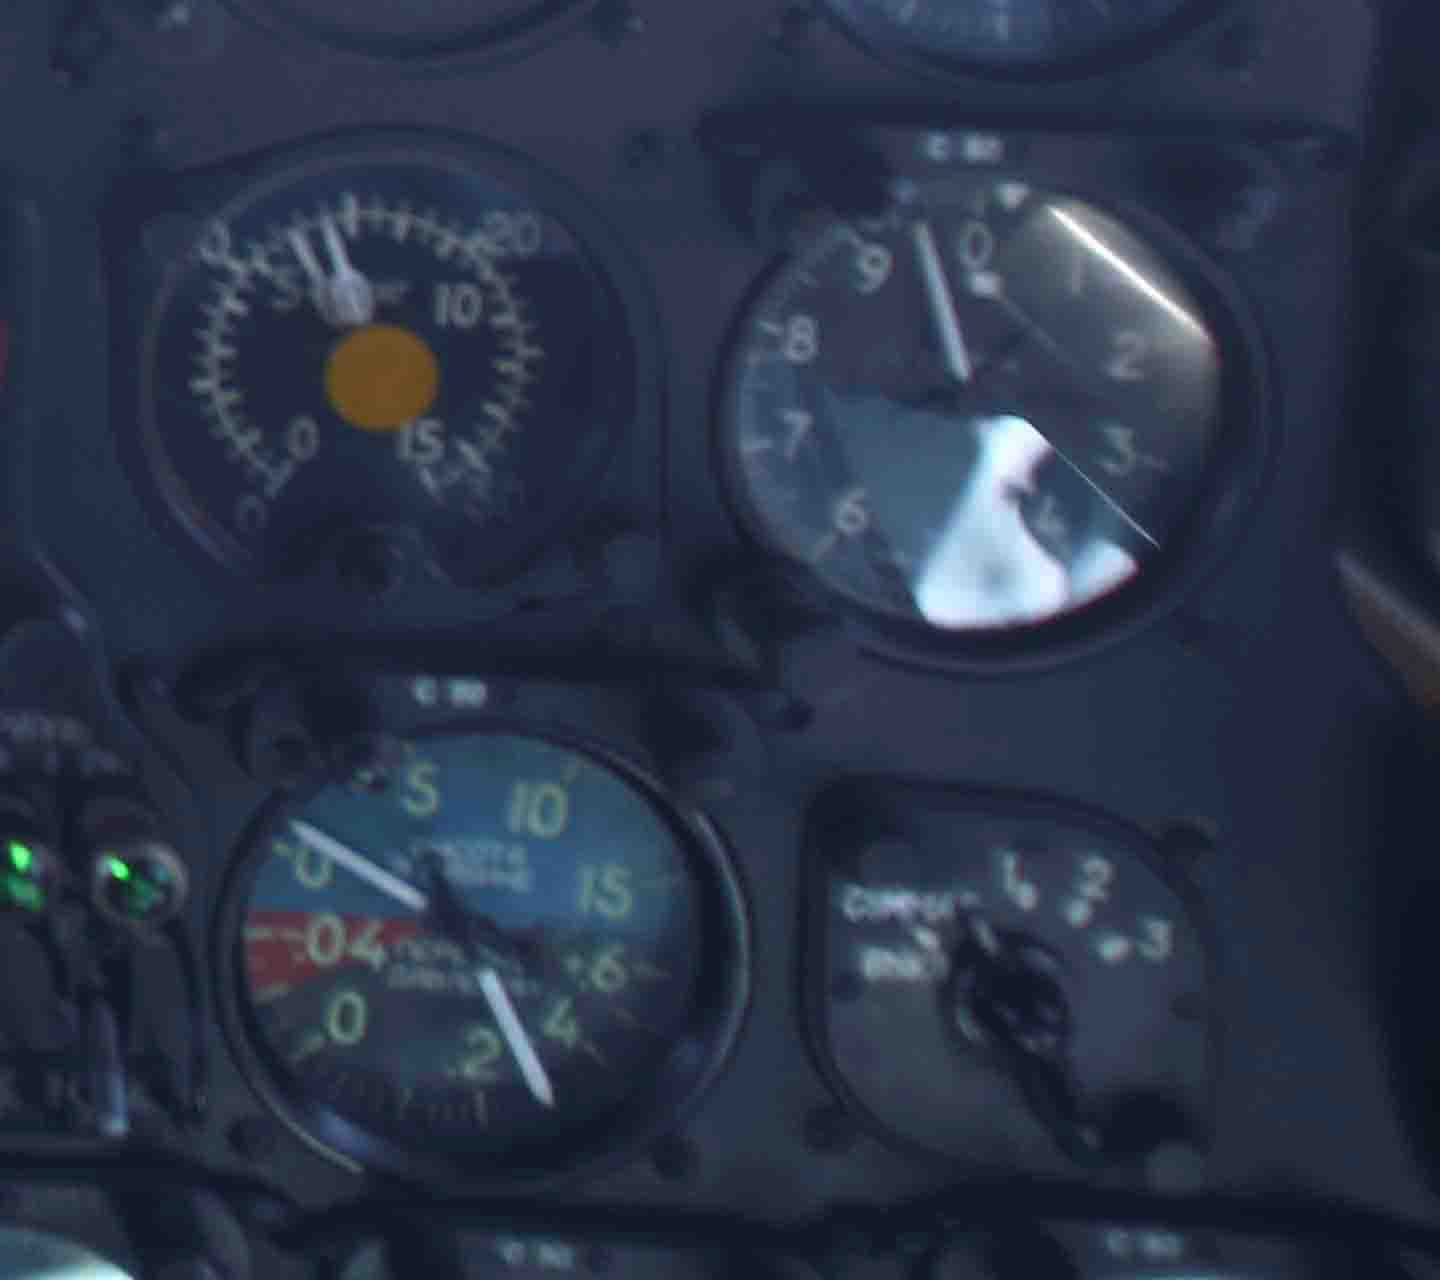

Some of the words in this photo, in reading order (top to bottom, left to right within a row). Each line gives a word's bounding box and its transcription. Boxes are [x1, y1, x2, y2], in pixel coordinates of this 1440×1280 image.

[849, 242, 894, 295] 9
[433, 283, 484, 329] 10
[782, 313, 819, 365] 8
[286, 414, 320, 462] 0
[397, 417, 446, 465] 15
[777, 408, 815, 461] 7
[831, 487, 870, 536] 6
[401, 760, 440, 818] 5
[508, 780, 568, 839] 10
[576, 862, 635, 920] 15
[326, 988, 368, 1046] 0
